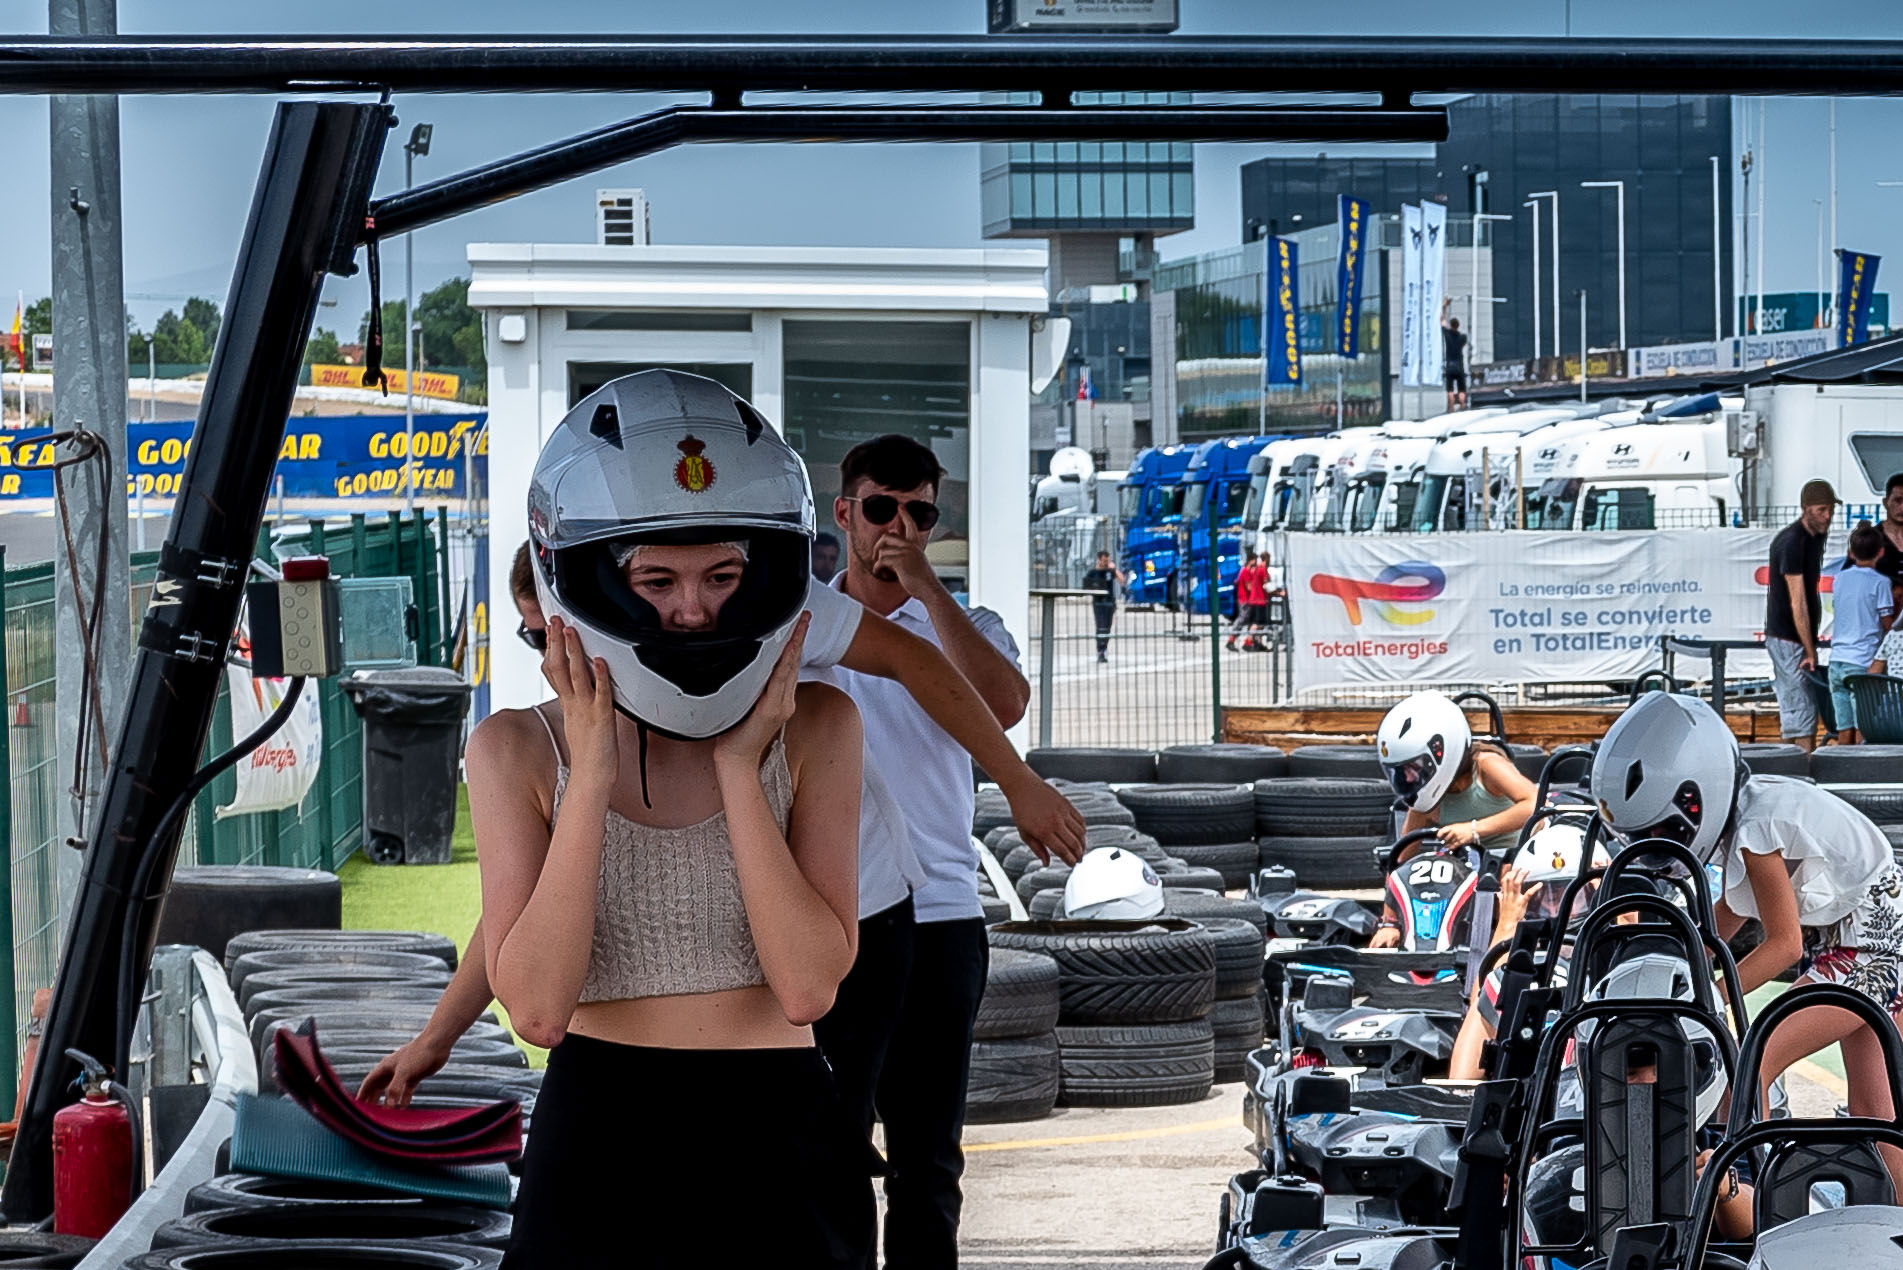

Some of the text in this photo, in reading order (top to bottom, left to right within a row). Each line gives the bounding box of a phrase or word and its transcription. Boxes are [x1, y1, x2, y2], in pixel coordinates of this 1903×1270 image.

[321, 369, 350, 384] DHL
[337, 466, 455, 497] GOODYEAR
[1499, 579, 1703, 599] La energía se reinventa.
[1489, 605, 1712, 629] Total se convierte
[1311, 638, 1448, 661] TotalEnergies
[1493, 638, 1521, 654] en
[1409, 860, 1453, 885] 20
